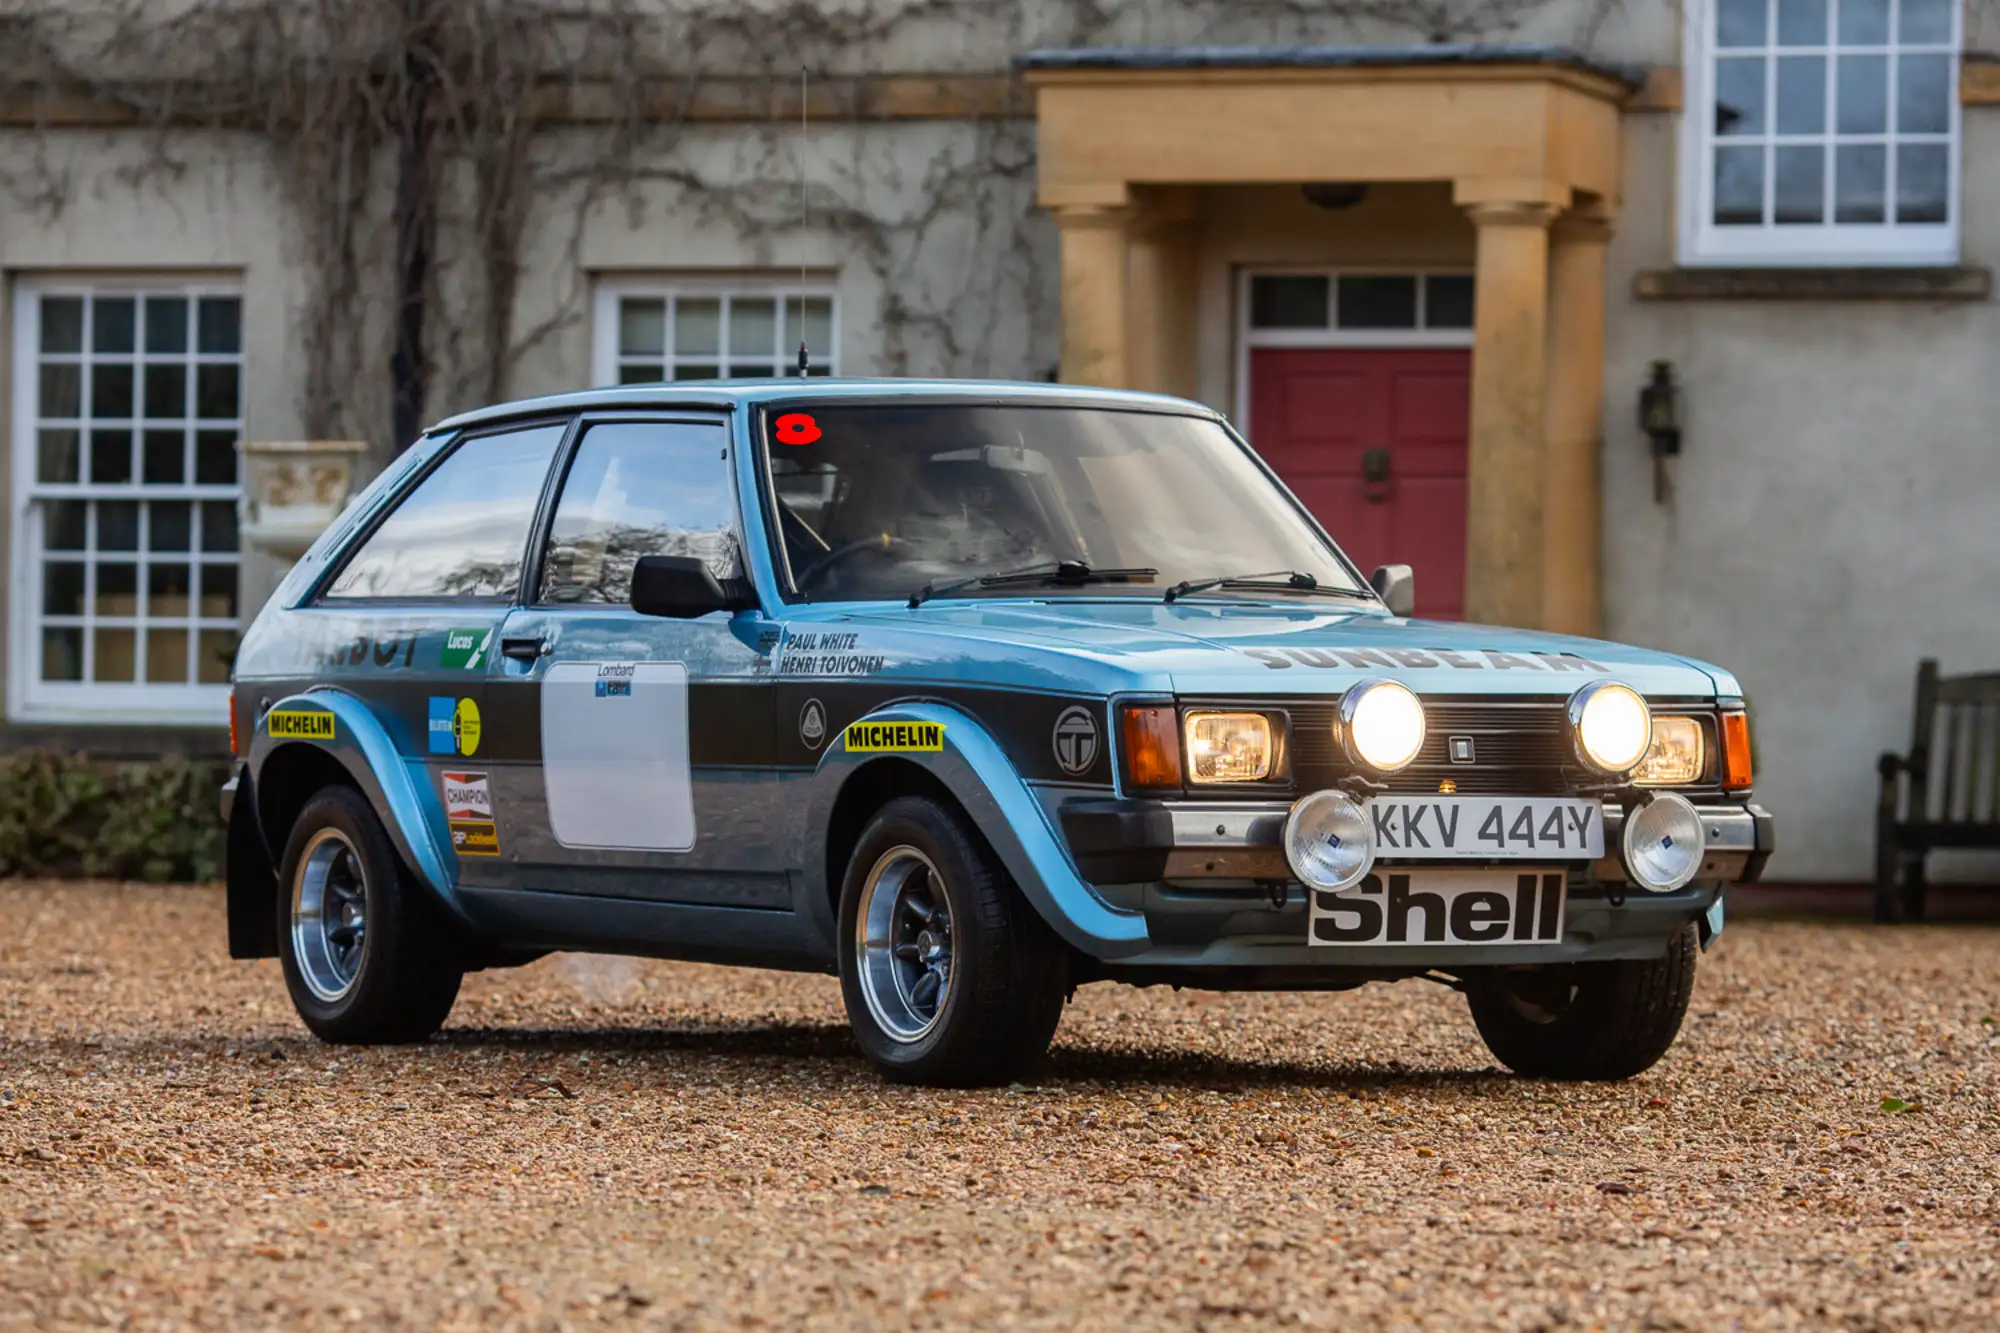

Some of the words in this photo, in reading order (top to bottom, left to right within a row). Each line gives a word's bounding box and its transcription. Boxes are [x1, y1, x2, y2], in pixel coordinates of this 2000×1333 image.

[447, 631, 473, 649] Lucas
[786, 633, 817, 650] PAUL
[819, 633, 859, 650] WHITE
[597, 662, 636, 677] Lombard
[781, 655, 817, 673] HENRI
[819, 656, 885, 673] TOIVONEN
[1243, 647, 1611, 673] SUNBEAM
[271, 714, 332, 735] MICHELIN
[849, 726, 940, 747] MICHELIN
[447, 787, 490, 804] CHAMPION
[1371, 803, 1460, 849] KKV
[1477, 804, 1594, 850] 444Y
[1313, 874, 1561, 943] Shell
